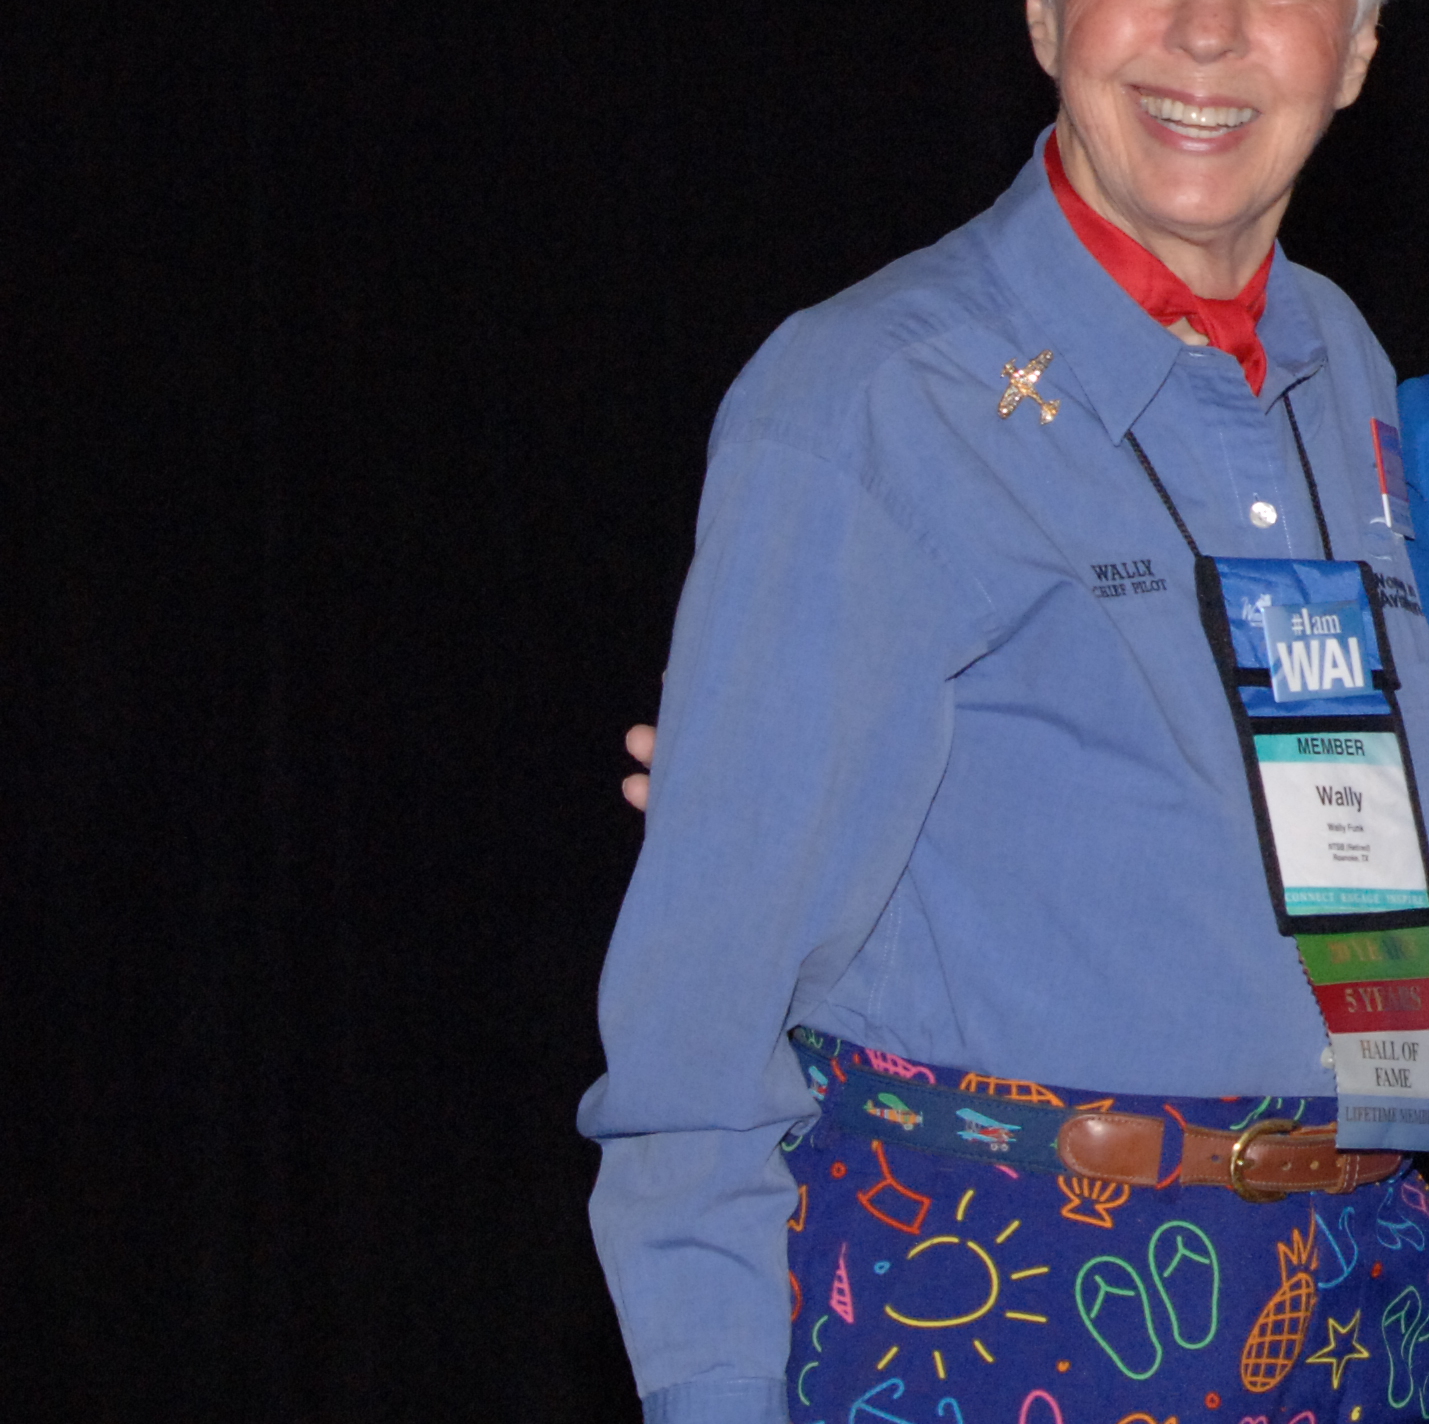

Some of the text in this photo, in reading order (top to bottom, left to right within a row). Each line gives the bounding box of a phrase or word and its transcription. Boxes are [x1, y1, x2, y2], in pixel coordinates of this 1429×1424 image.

[1090, 558, 1155, 582] WALLY
[1092, 578, 1168, 598] CHIEF PILOT
[1276, 636, 1365, 693] WAI
[1297, 737, 1366, 757] MEMBER
[1315, 785, 1363, 813] Wally
[1344, 985, 1422, 1014] 5 YEARS
[1359, 1039, 1420, 1062] HALL OF
[1374, 1067, 1412, 1089] FAME
[1345, 1105, 1398, 1123] LIFETIME
